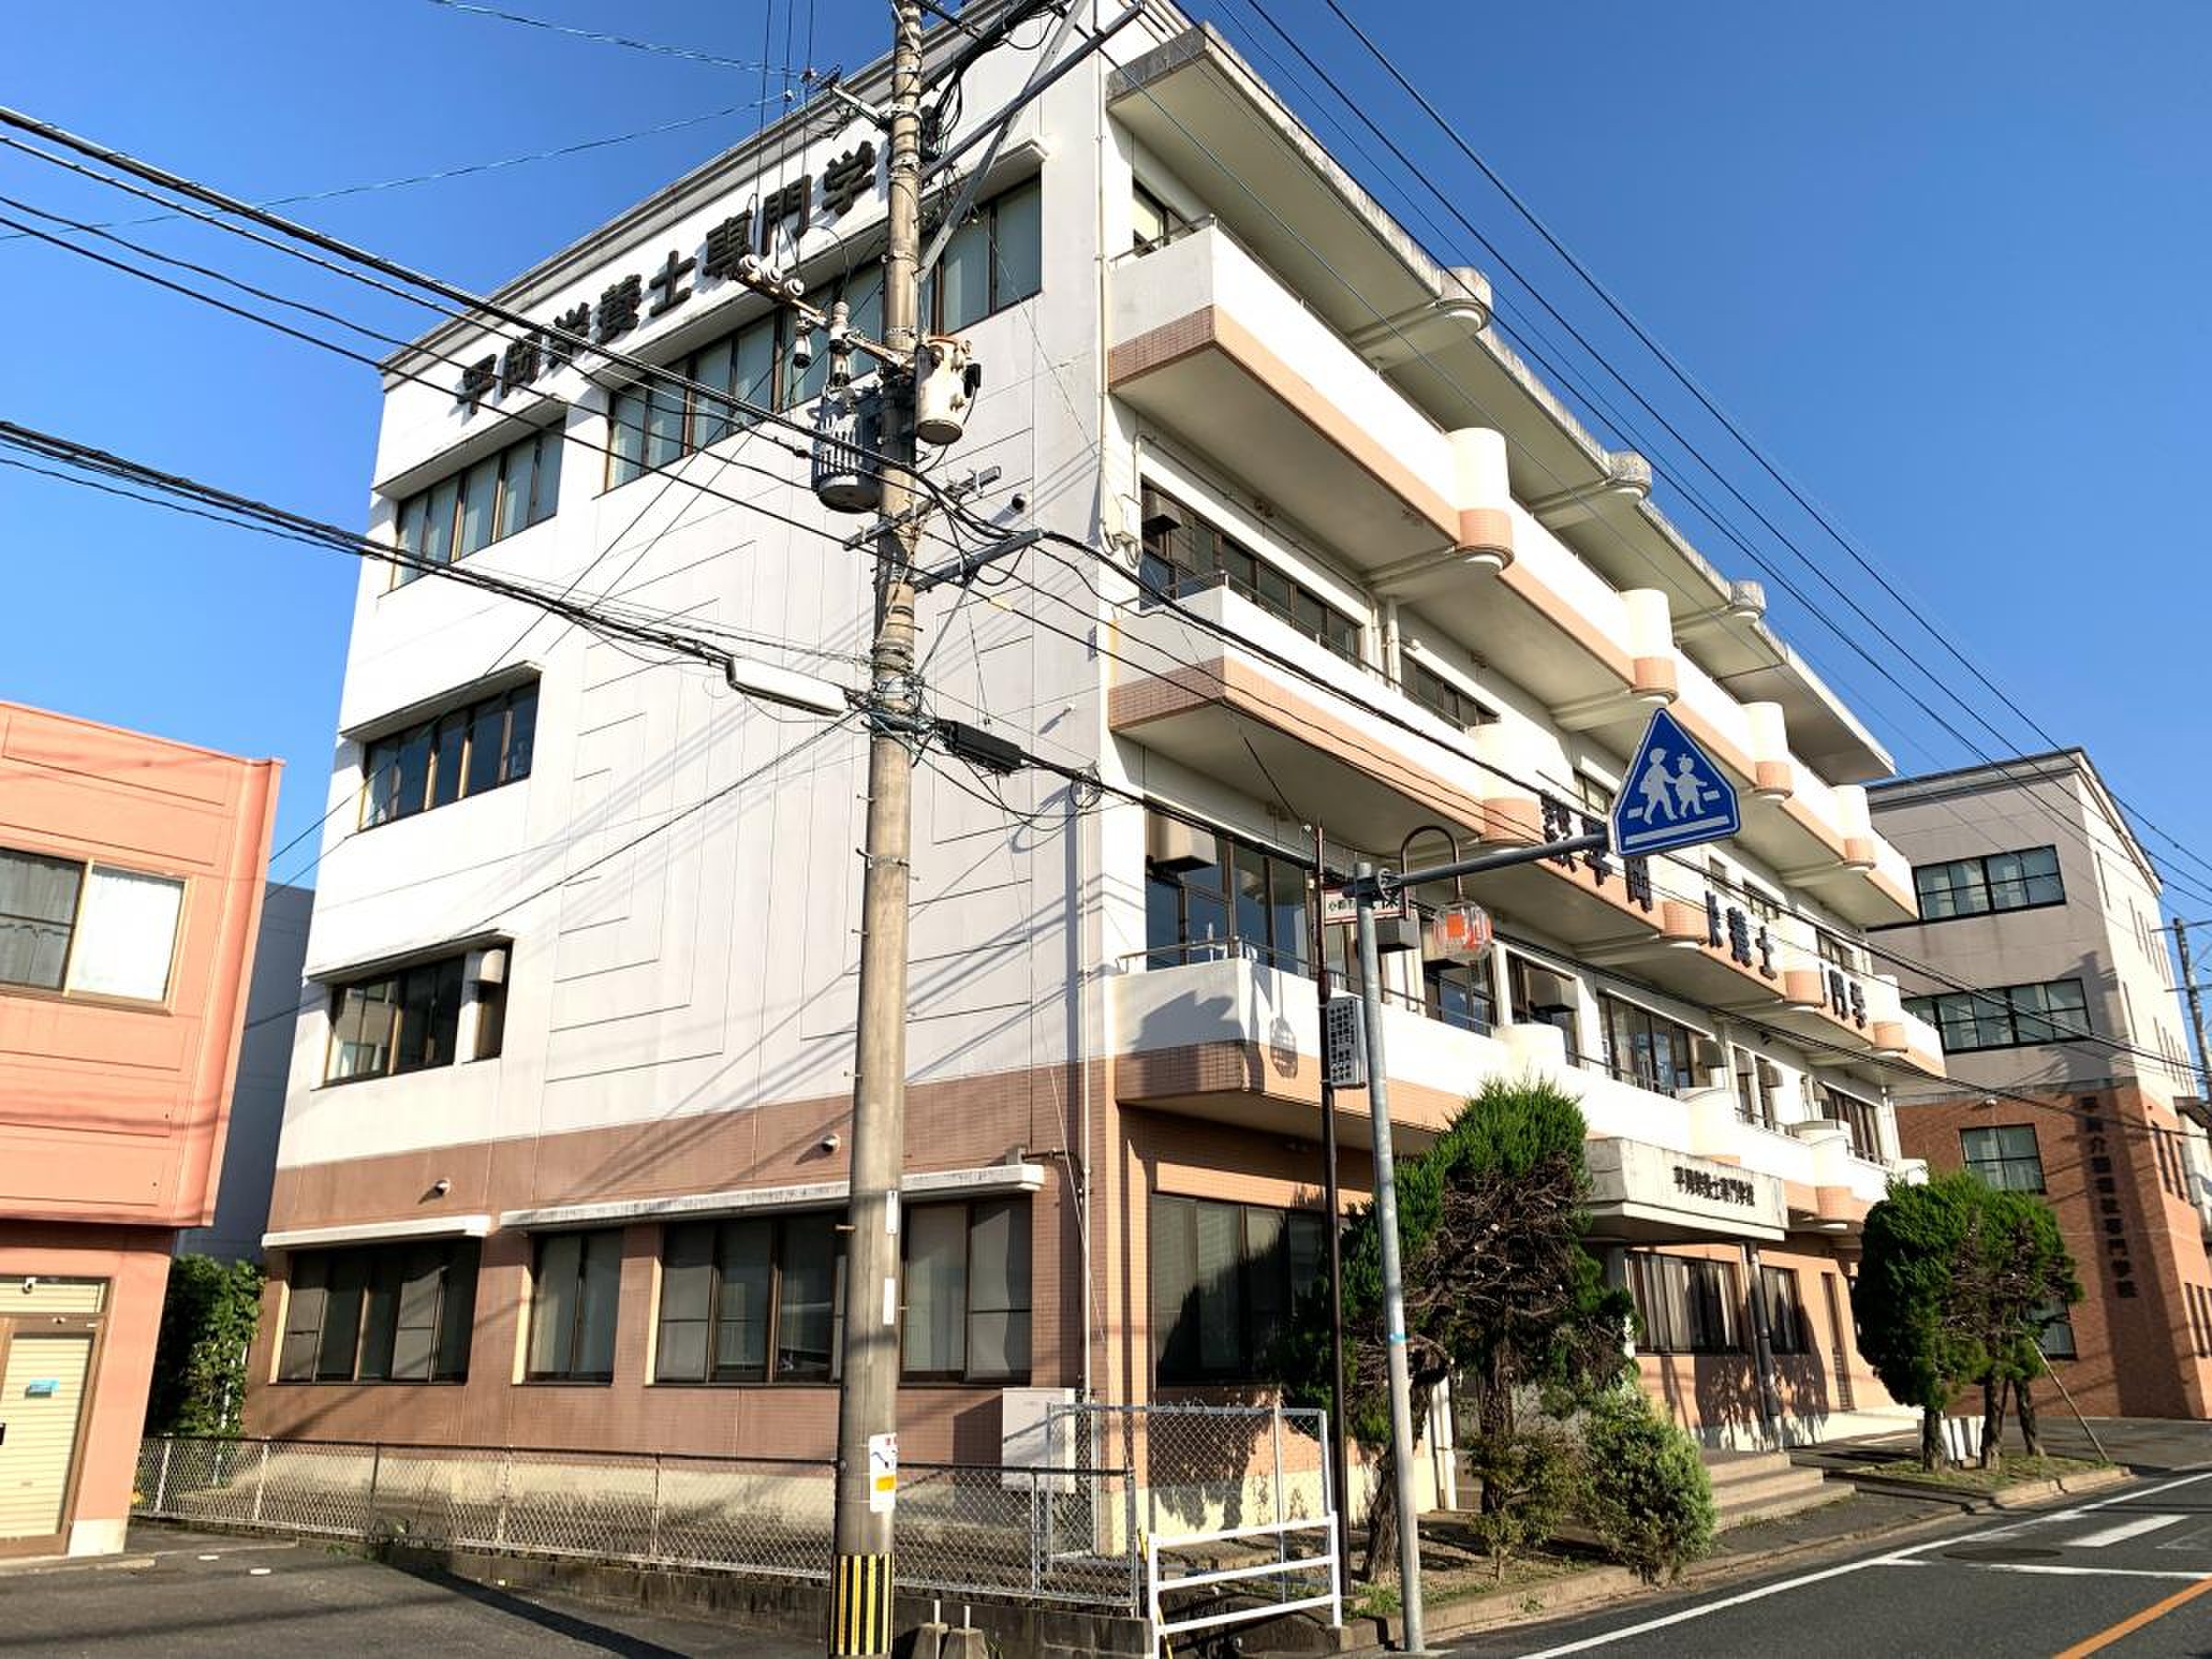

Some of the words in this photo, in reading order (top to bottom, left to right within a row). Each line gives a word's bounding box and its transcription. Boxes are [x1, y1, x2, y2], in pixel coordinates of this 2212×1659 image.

[456, 105, 936, 415] 平岡栄養士専門学
